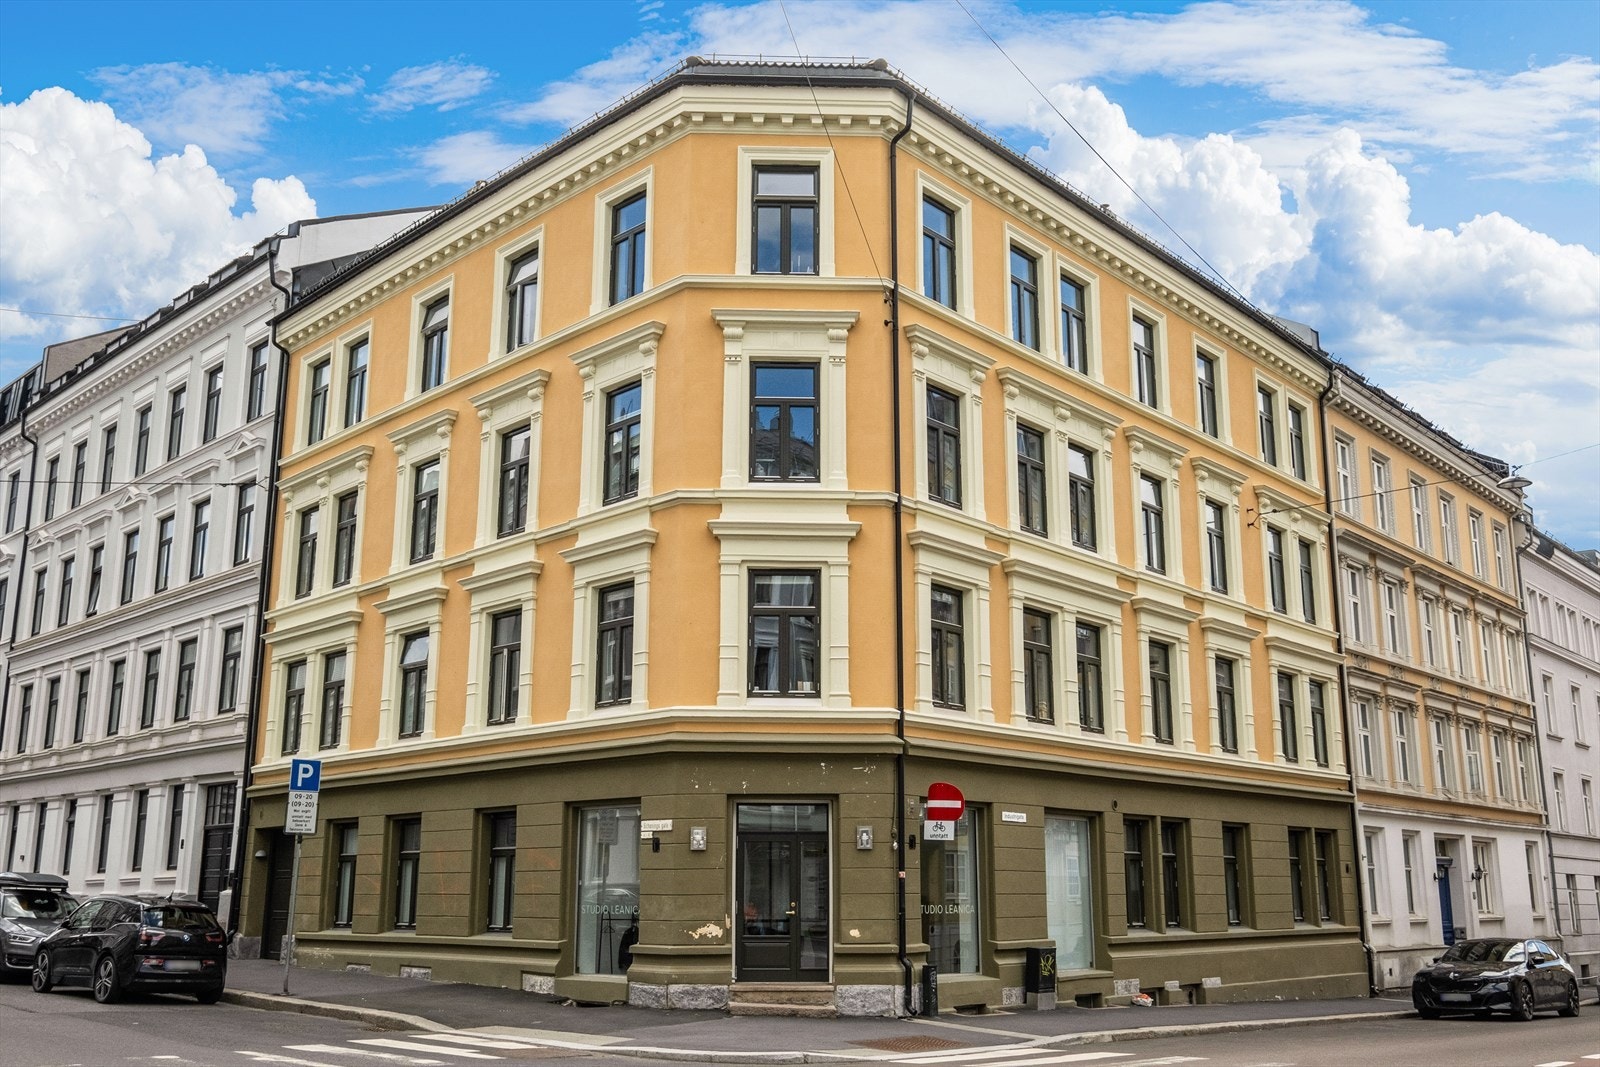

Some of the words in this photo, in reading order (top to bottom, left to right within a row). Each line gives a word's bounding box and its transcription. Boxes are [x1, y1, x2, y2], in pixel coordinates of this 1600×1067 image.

[297, 763, 314, 787] P
[581, 904, 609, 914] STUDIO
[920, 904, 943, 914] TUDIO
[945, 904, 975, 914] LEANICA
